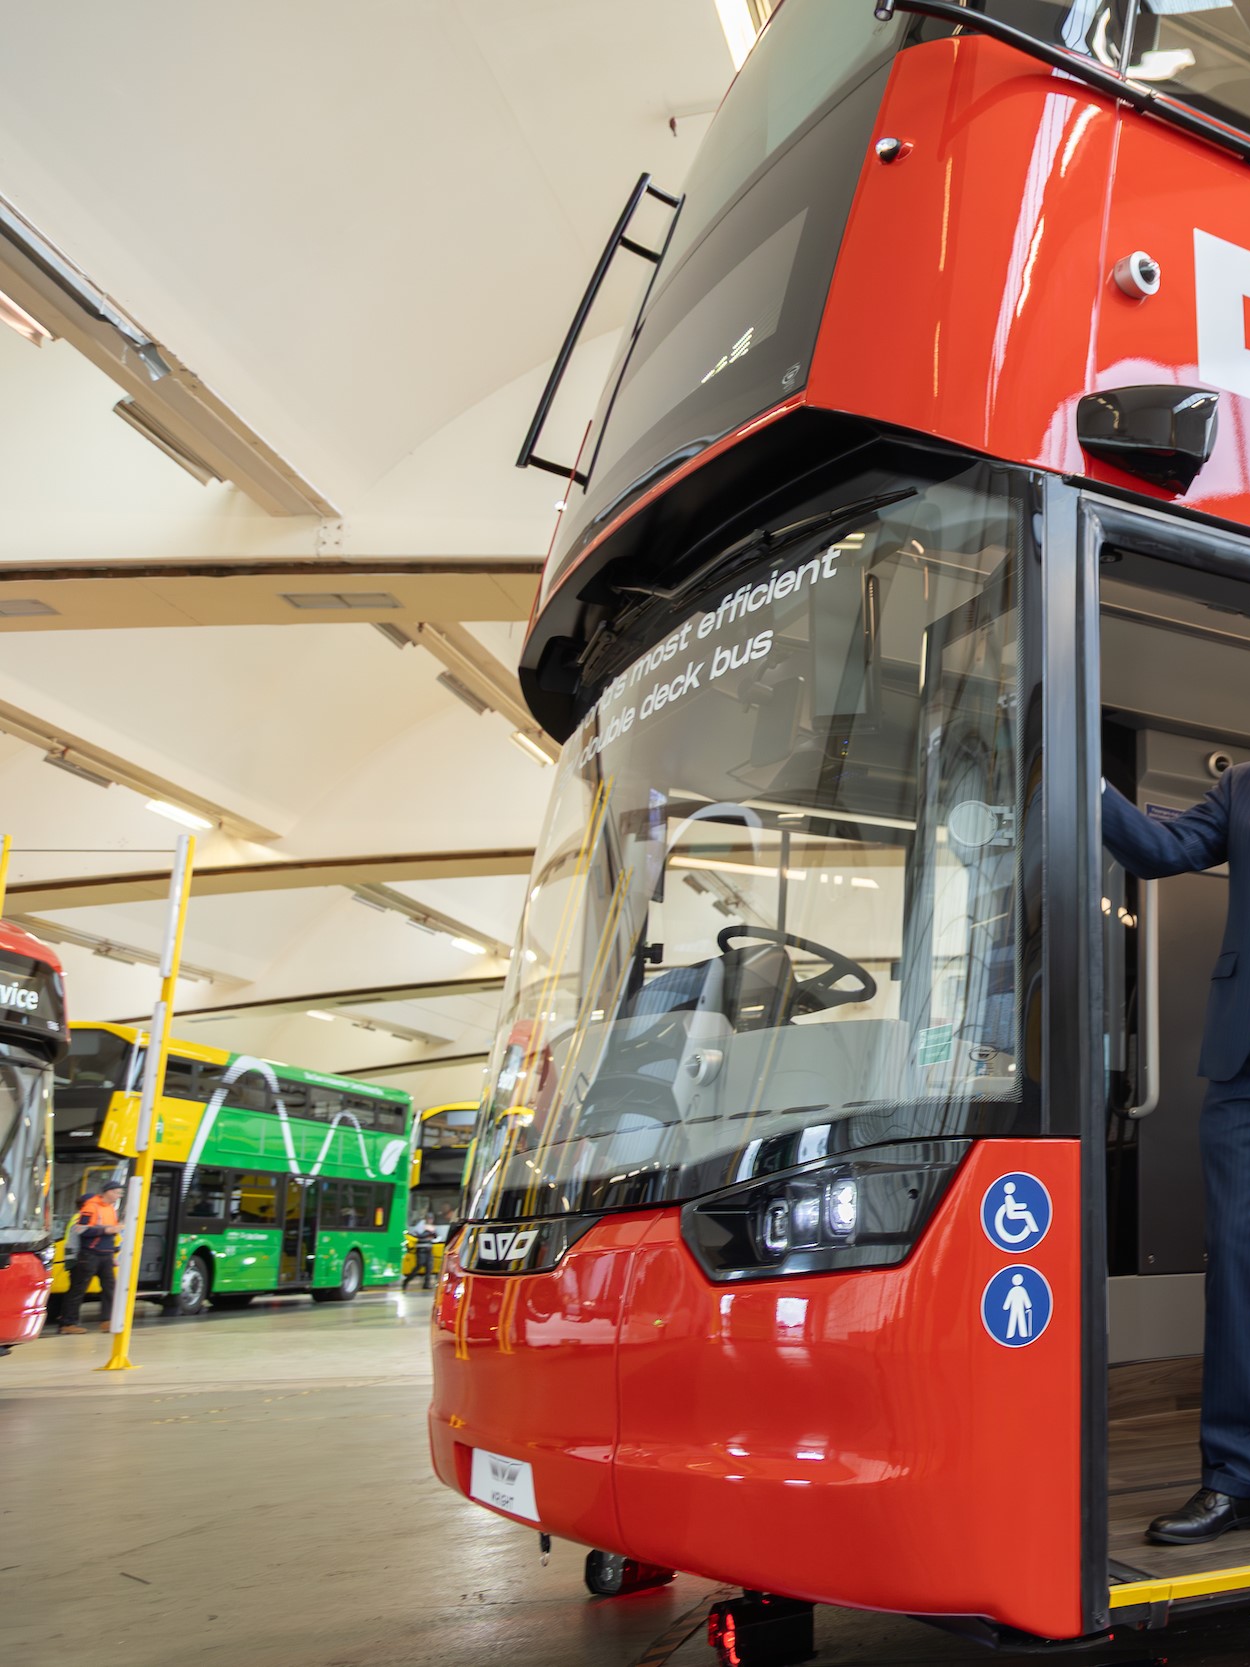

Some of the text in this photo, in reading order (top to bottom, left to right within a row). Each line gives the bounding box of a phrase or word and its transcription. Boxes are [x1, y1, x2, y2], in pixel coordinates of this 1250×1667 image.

[630, 622, 692, 687] most
[697, 546, 841, 639] efficient
[579, 706, 635, 769] double
[640, 661, 705, 720] deck
[709, 630, 774, 680] bus
